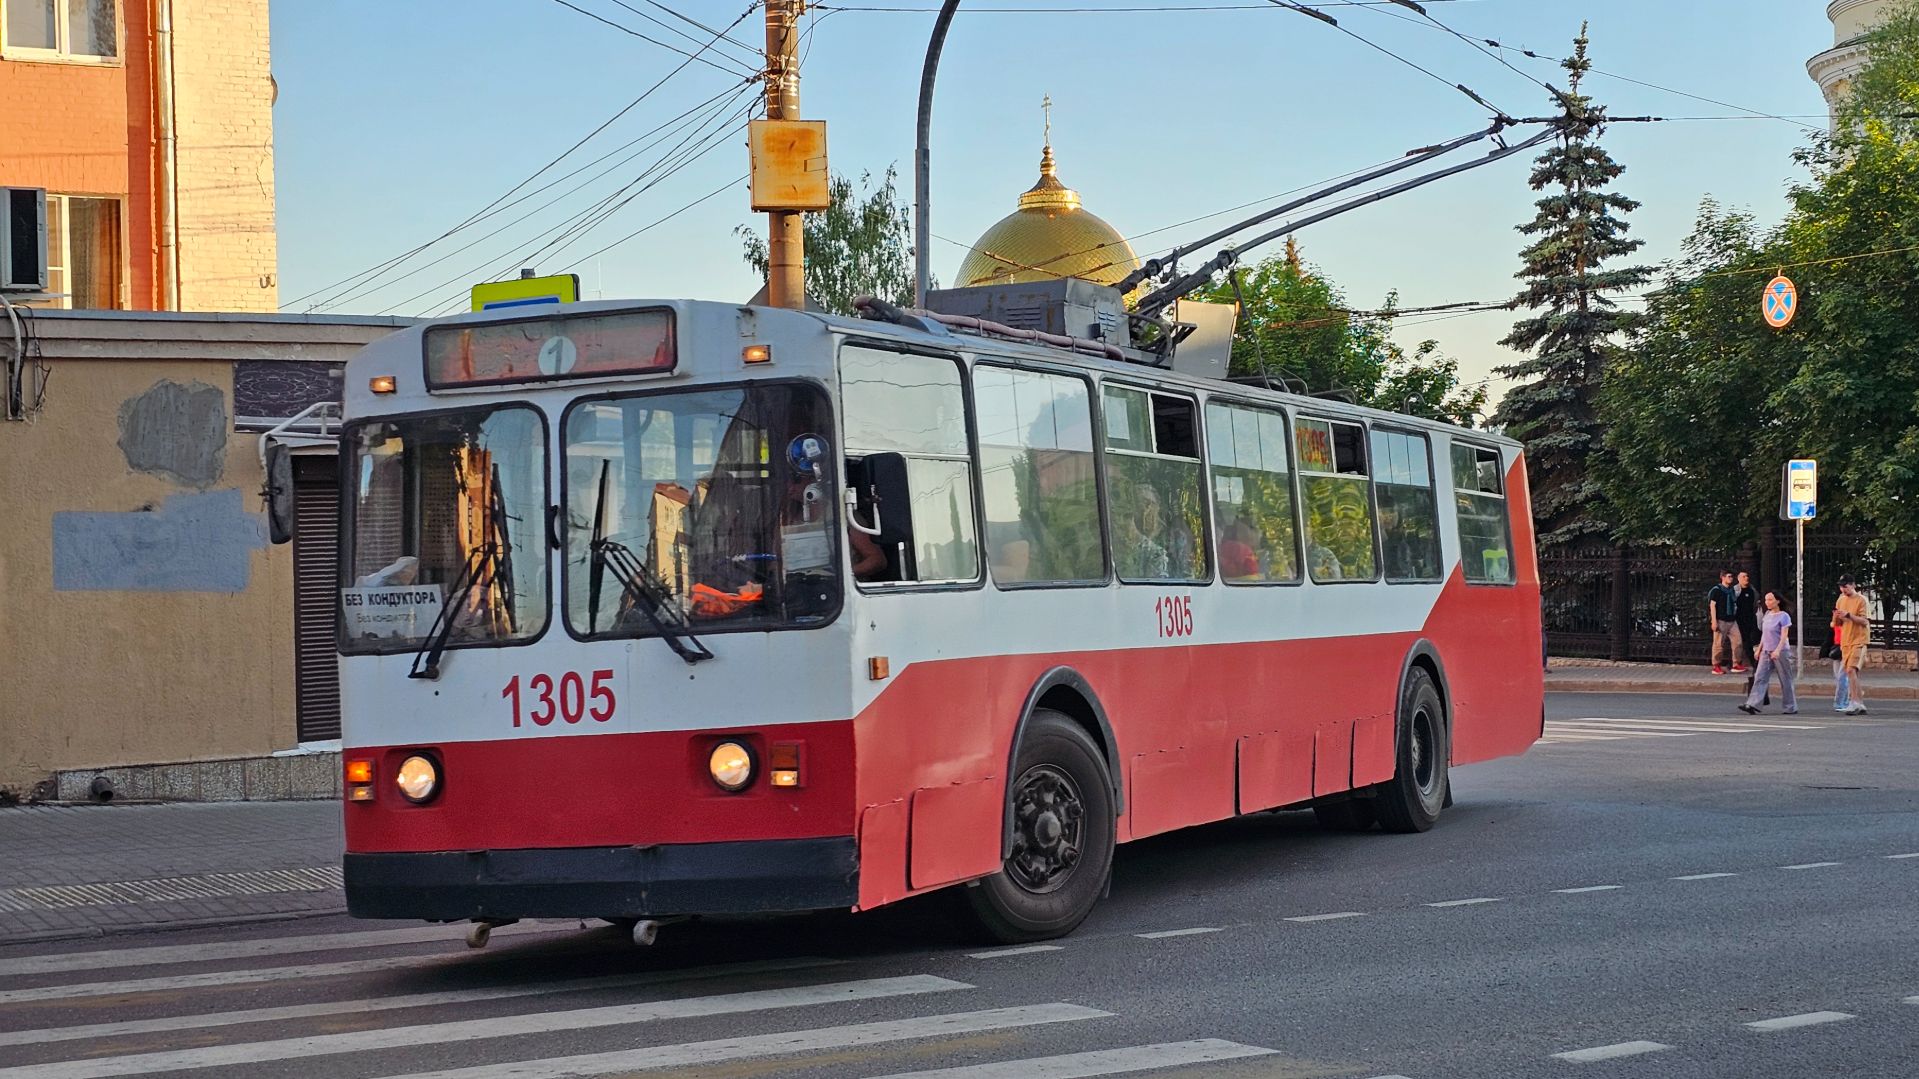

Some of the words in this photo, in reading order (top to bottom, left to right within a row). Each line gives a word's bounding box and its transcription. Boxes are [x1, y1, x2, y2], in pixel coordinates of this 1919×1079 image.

[548, 338, 563, 374] 1
[345, 593, 363, 606] БЕЗ
[368, 591, 437, 607] КОНДУКТОРА
[1155, 595, 1193, 638] 1305
[502, 669, 616, 727] 1305
